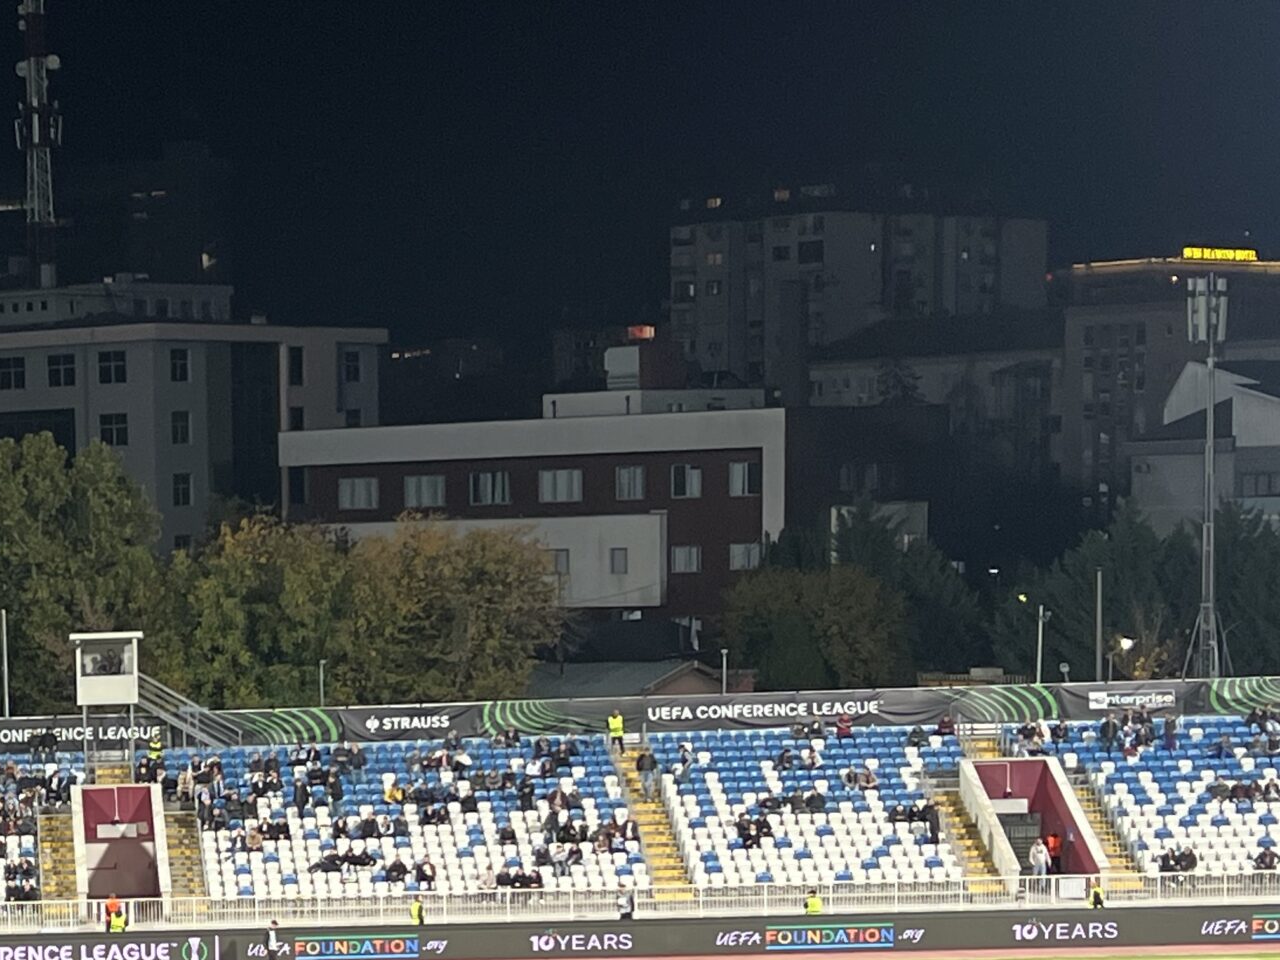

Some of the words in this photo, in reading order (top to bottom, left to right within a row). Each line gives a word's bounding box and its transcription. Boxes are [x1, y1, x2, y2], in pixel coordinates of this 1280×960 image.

[648, 706, 692, 721] UEFA
[696, 703, 808, 719] CONFERENCE
[382, 715, 450, 730] STRAUSS
[1201, 919, 1248, 935] UEFA
[716, 931, 761, 945] UEFA
[766, 927, 895, 944] FOUNDATION
[294, 939, 419, 955] FOUNDATION
